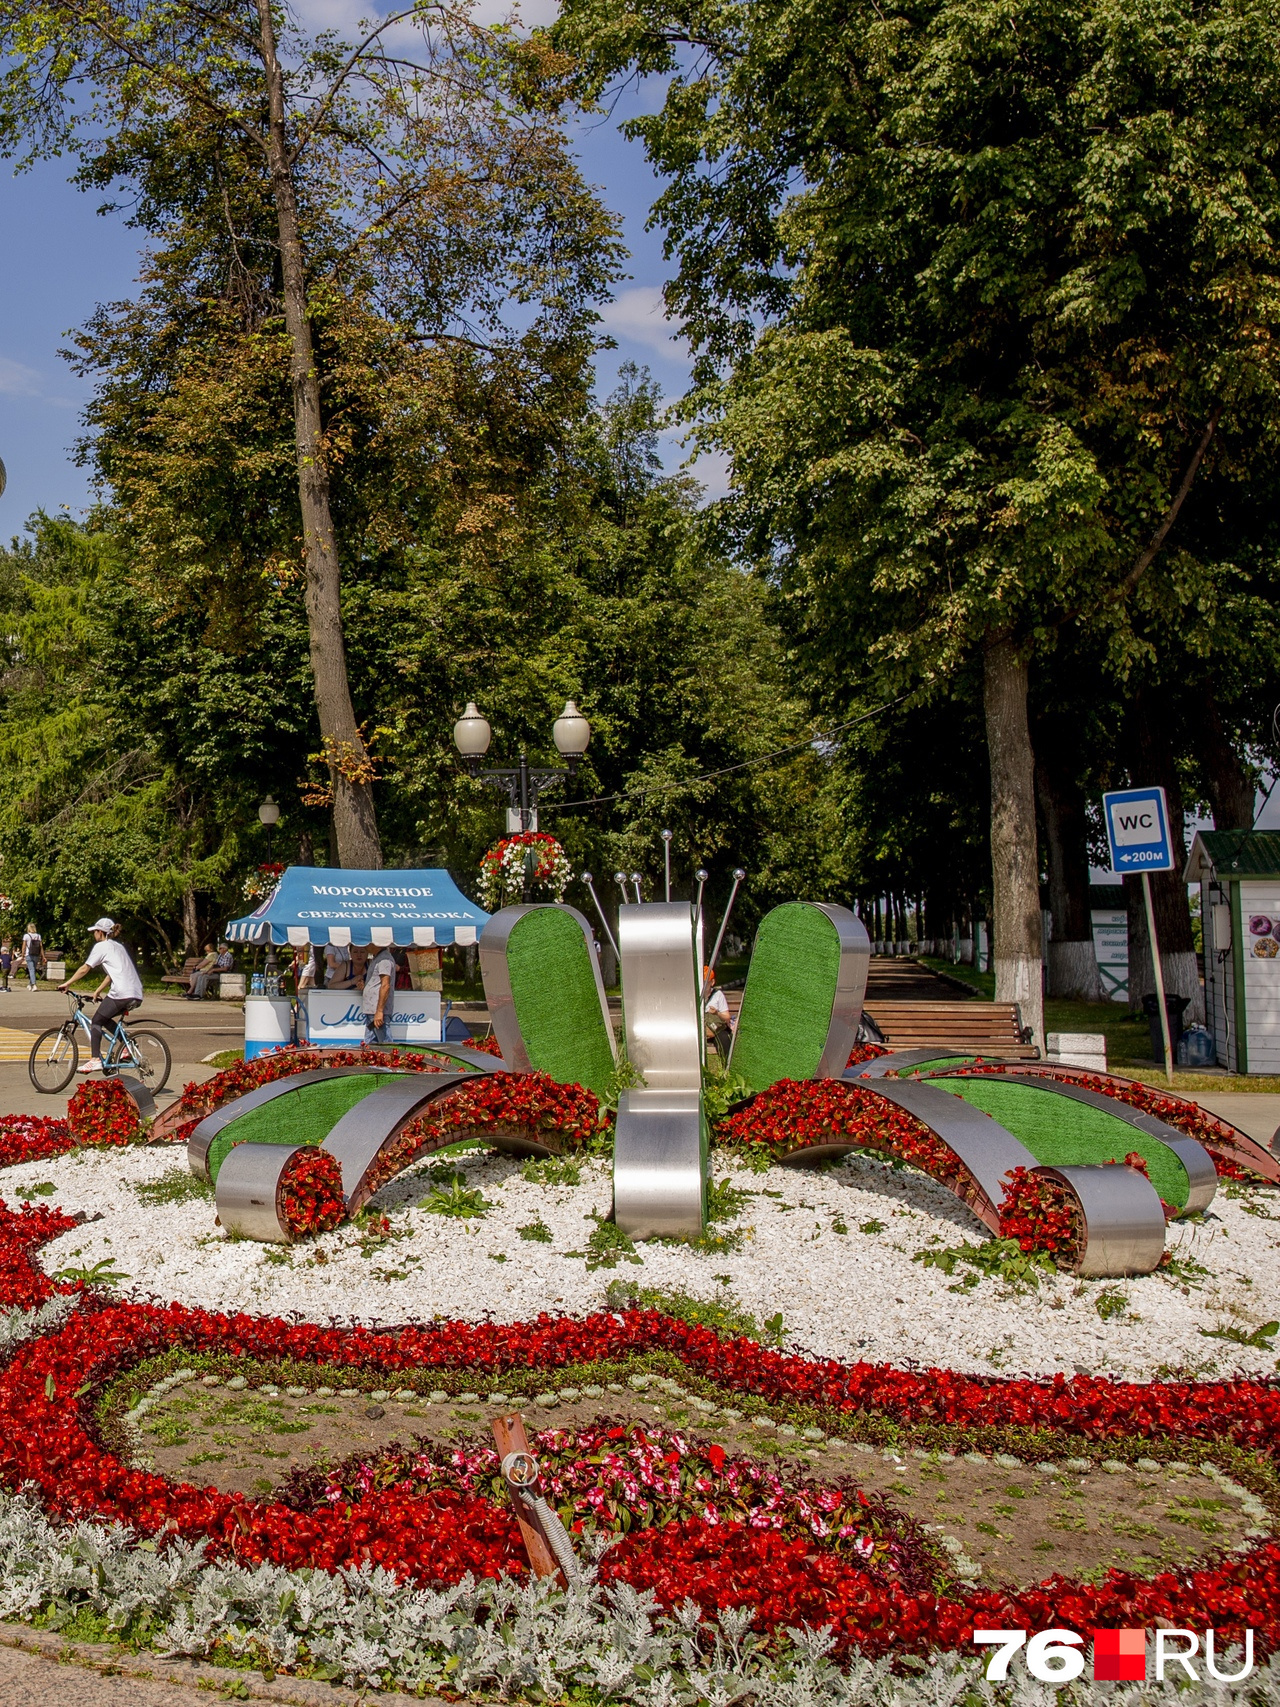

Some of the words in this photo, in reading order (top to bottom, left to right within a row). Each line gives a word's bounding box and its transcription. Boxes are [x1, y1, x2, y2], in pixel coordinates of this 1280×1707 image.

[1118, 813, 1153, 831] WC
[311, 885, 434, 897] МОРОЖЕНОЕ
[297, 911, 385, 919] СВЕЖЕГО
[391, 911, 476, 919] МОЛОКА
